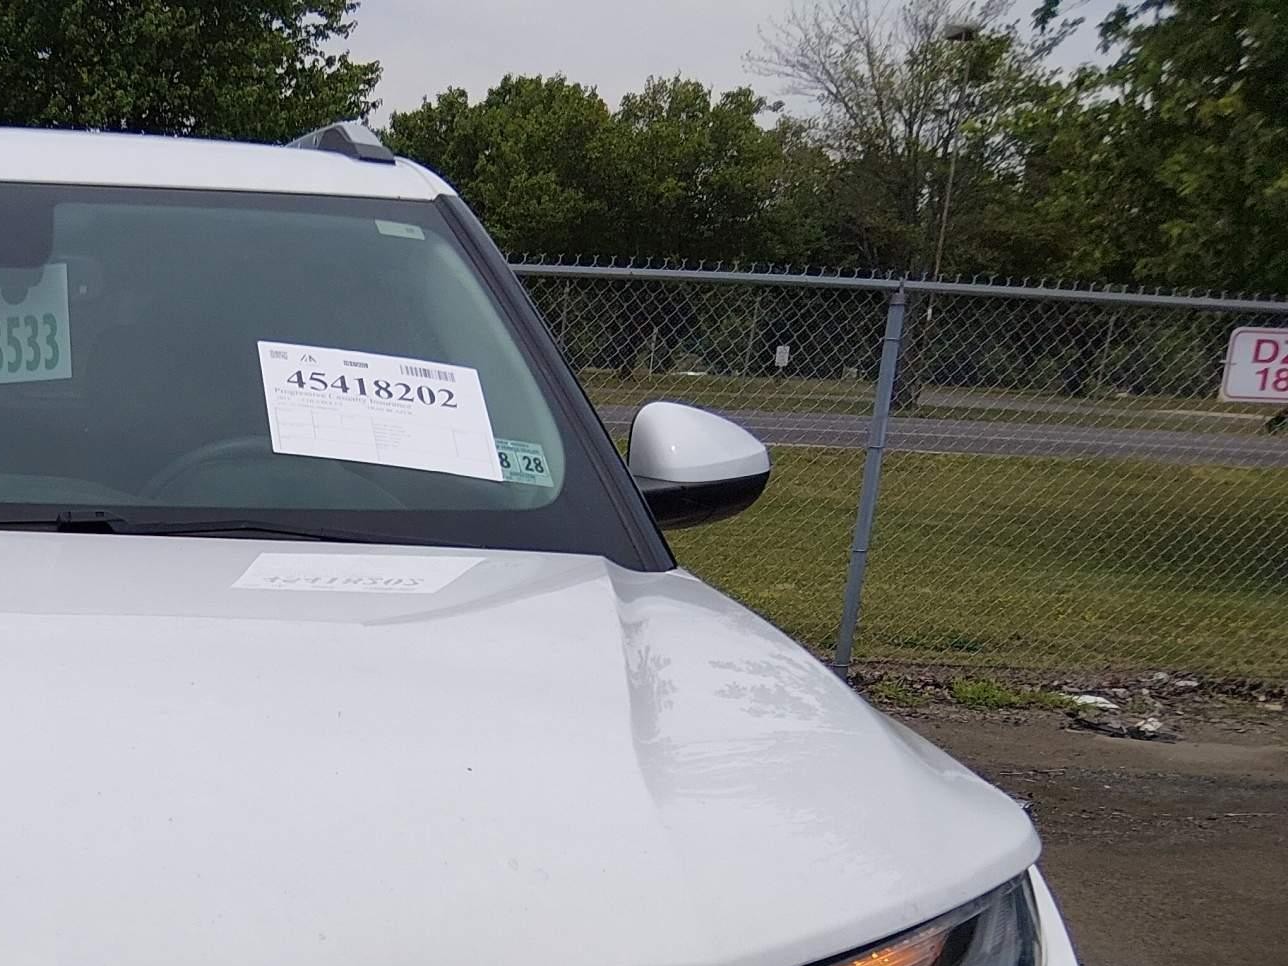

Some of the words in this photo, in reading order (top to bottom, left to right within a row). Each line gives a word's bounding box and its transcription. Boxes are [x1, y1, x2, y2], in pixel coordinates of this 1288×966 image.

[287, 370, 458, 408] 45418202
[1255, 367, 1288, 392] 18
[522, 455, 545, 473] 28
